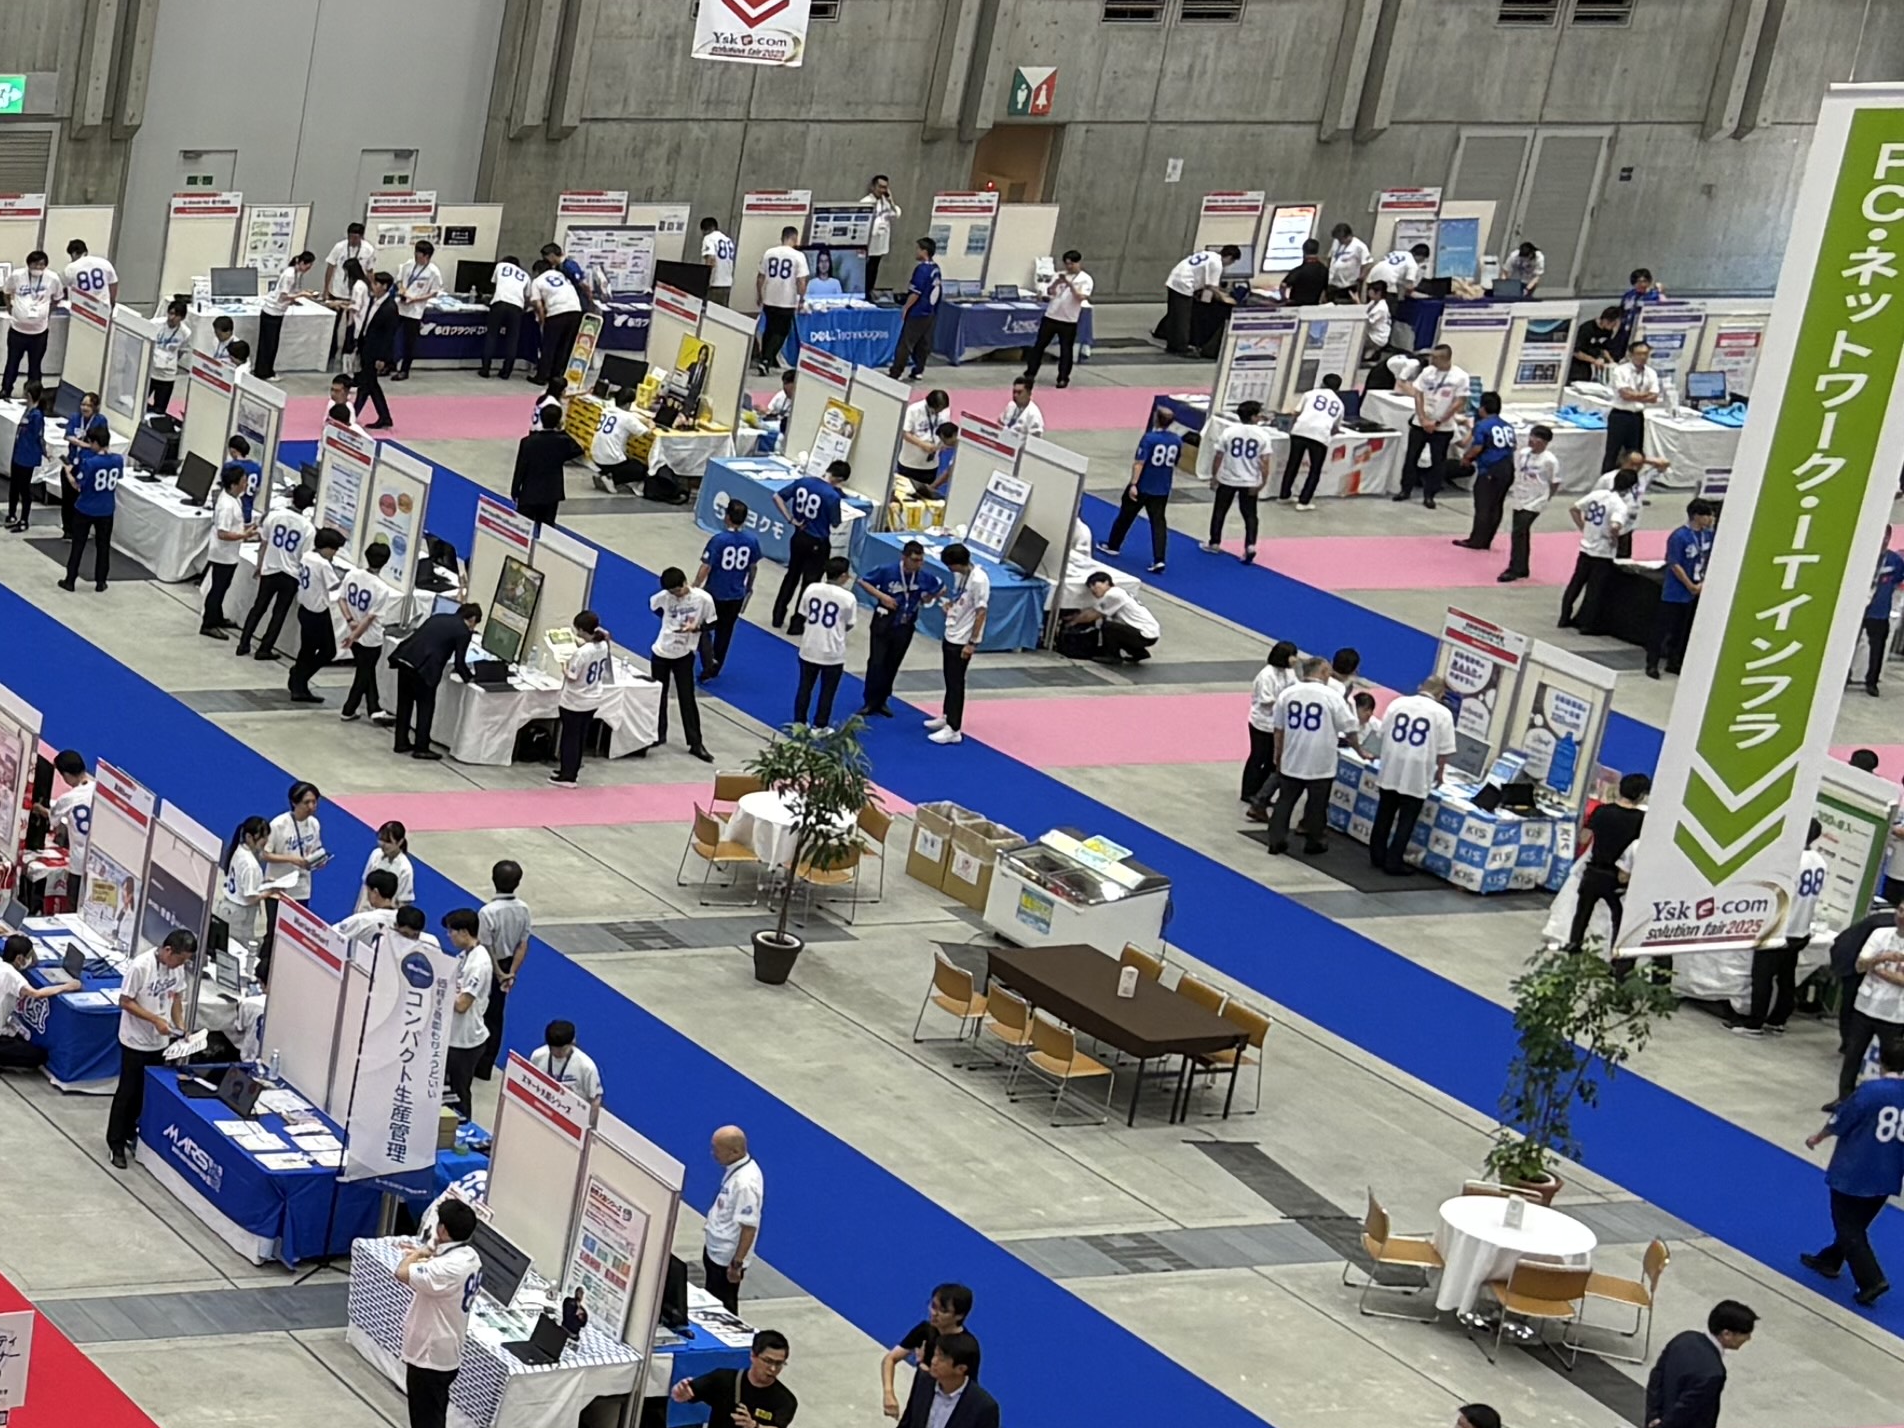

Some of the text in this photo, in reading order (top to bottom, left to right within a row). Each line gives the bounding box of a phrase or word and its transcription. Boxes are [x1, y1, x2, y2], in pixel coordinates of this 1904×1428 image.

[766, 256, 793, 279] 88
[75, 269, 105, 292] 88
[1313, 394, 1340, 417] 88
[1150, 444, 1178, 468] 88
[1230, 438, 1259, 462] 88
[94, 468, 119, 492] 88
[795, 486, 822, 520] 88
[271, 524, 303, 554] 88
[721, 545, 752, 572] 88
[345, 585, 373, 612] 88
[808, 597, 839, 629] 88
[1286, 701, 1322, 733] 88
[1391, 713, 1429, 747] 88
[1466, 824, 1487, 839] KIS
[1460, 846, 1482, 862] KIS
[1799, 867, 1826, 897] 88
[1651, 901, 1691, 924] Ysk
[1645, 922, 1700, 940] solution
[1725, 918, 1765, 936] 2025
[387, 990, 423, 1165] コンパクト生産管理
